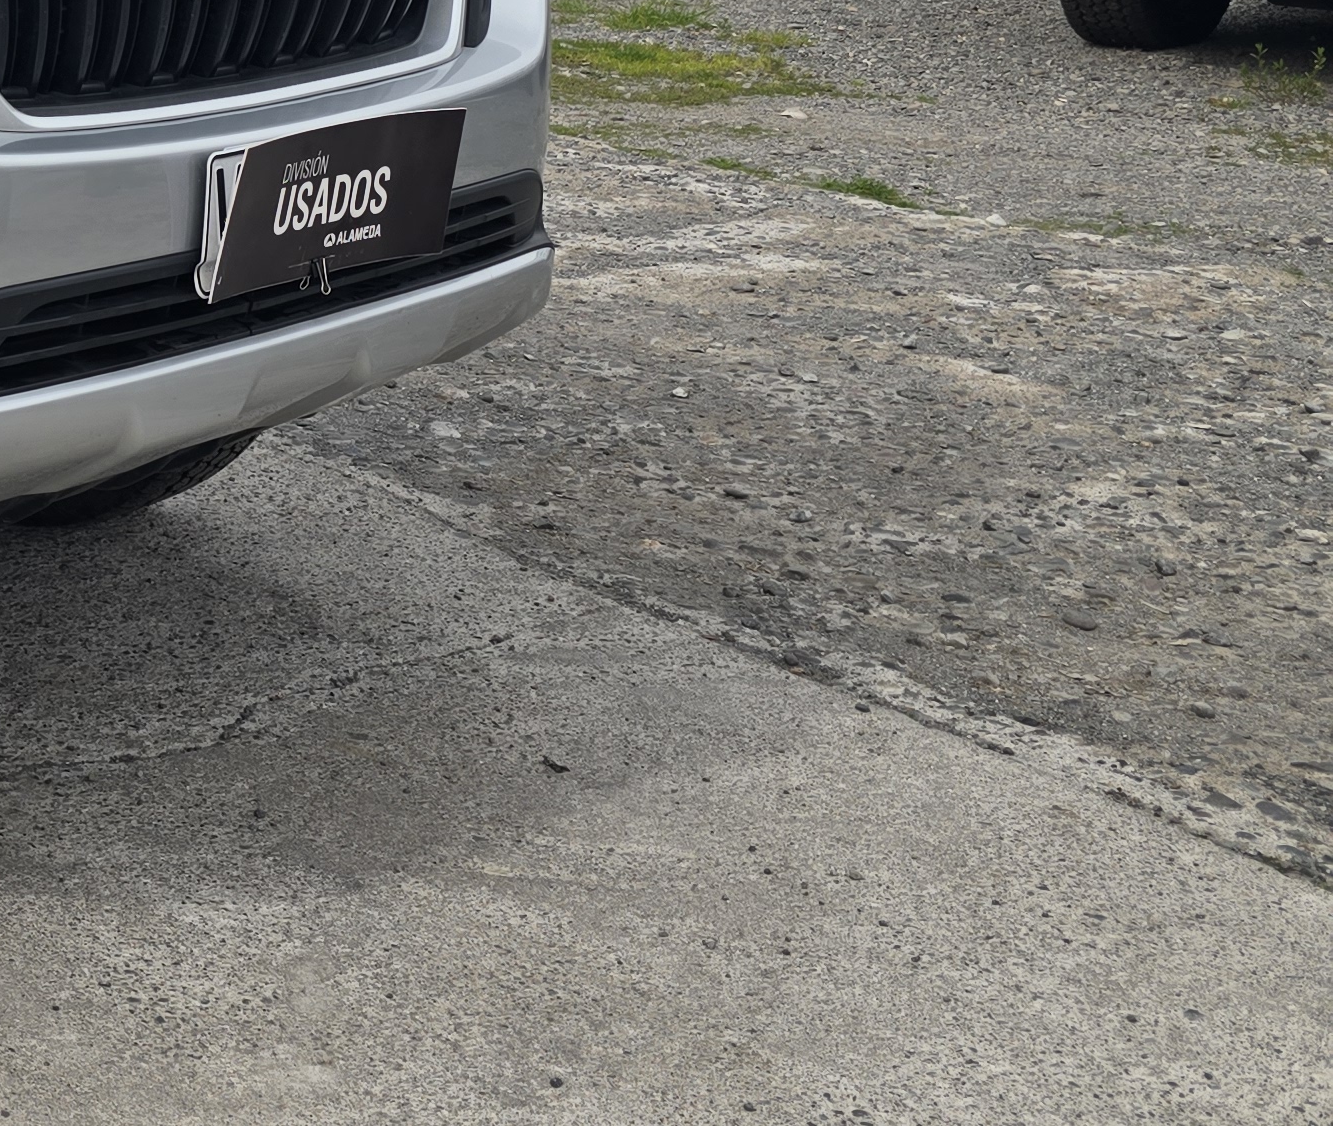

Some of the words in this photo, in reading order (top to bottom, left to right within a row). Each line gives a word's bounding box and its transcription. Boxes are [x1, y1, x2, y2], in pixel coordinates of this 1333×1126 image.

[282, 150, 330, 184] DIVISIÓN
[273, 165, 391, 235] USADOS
[336, 224, 382, 245] ALAMEDA
